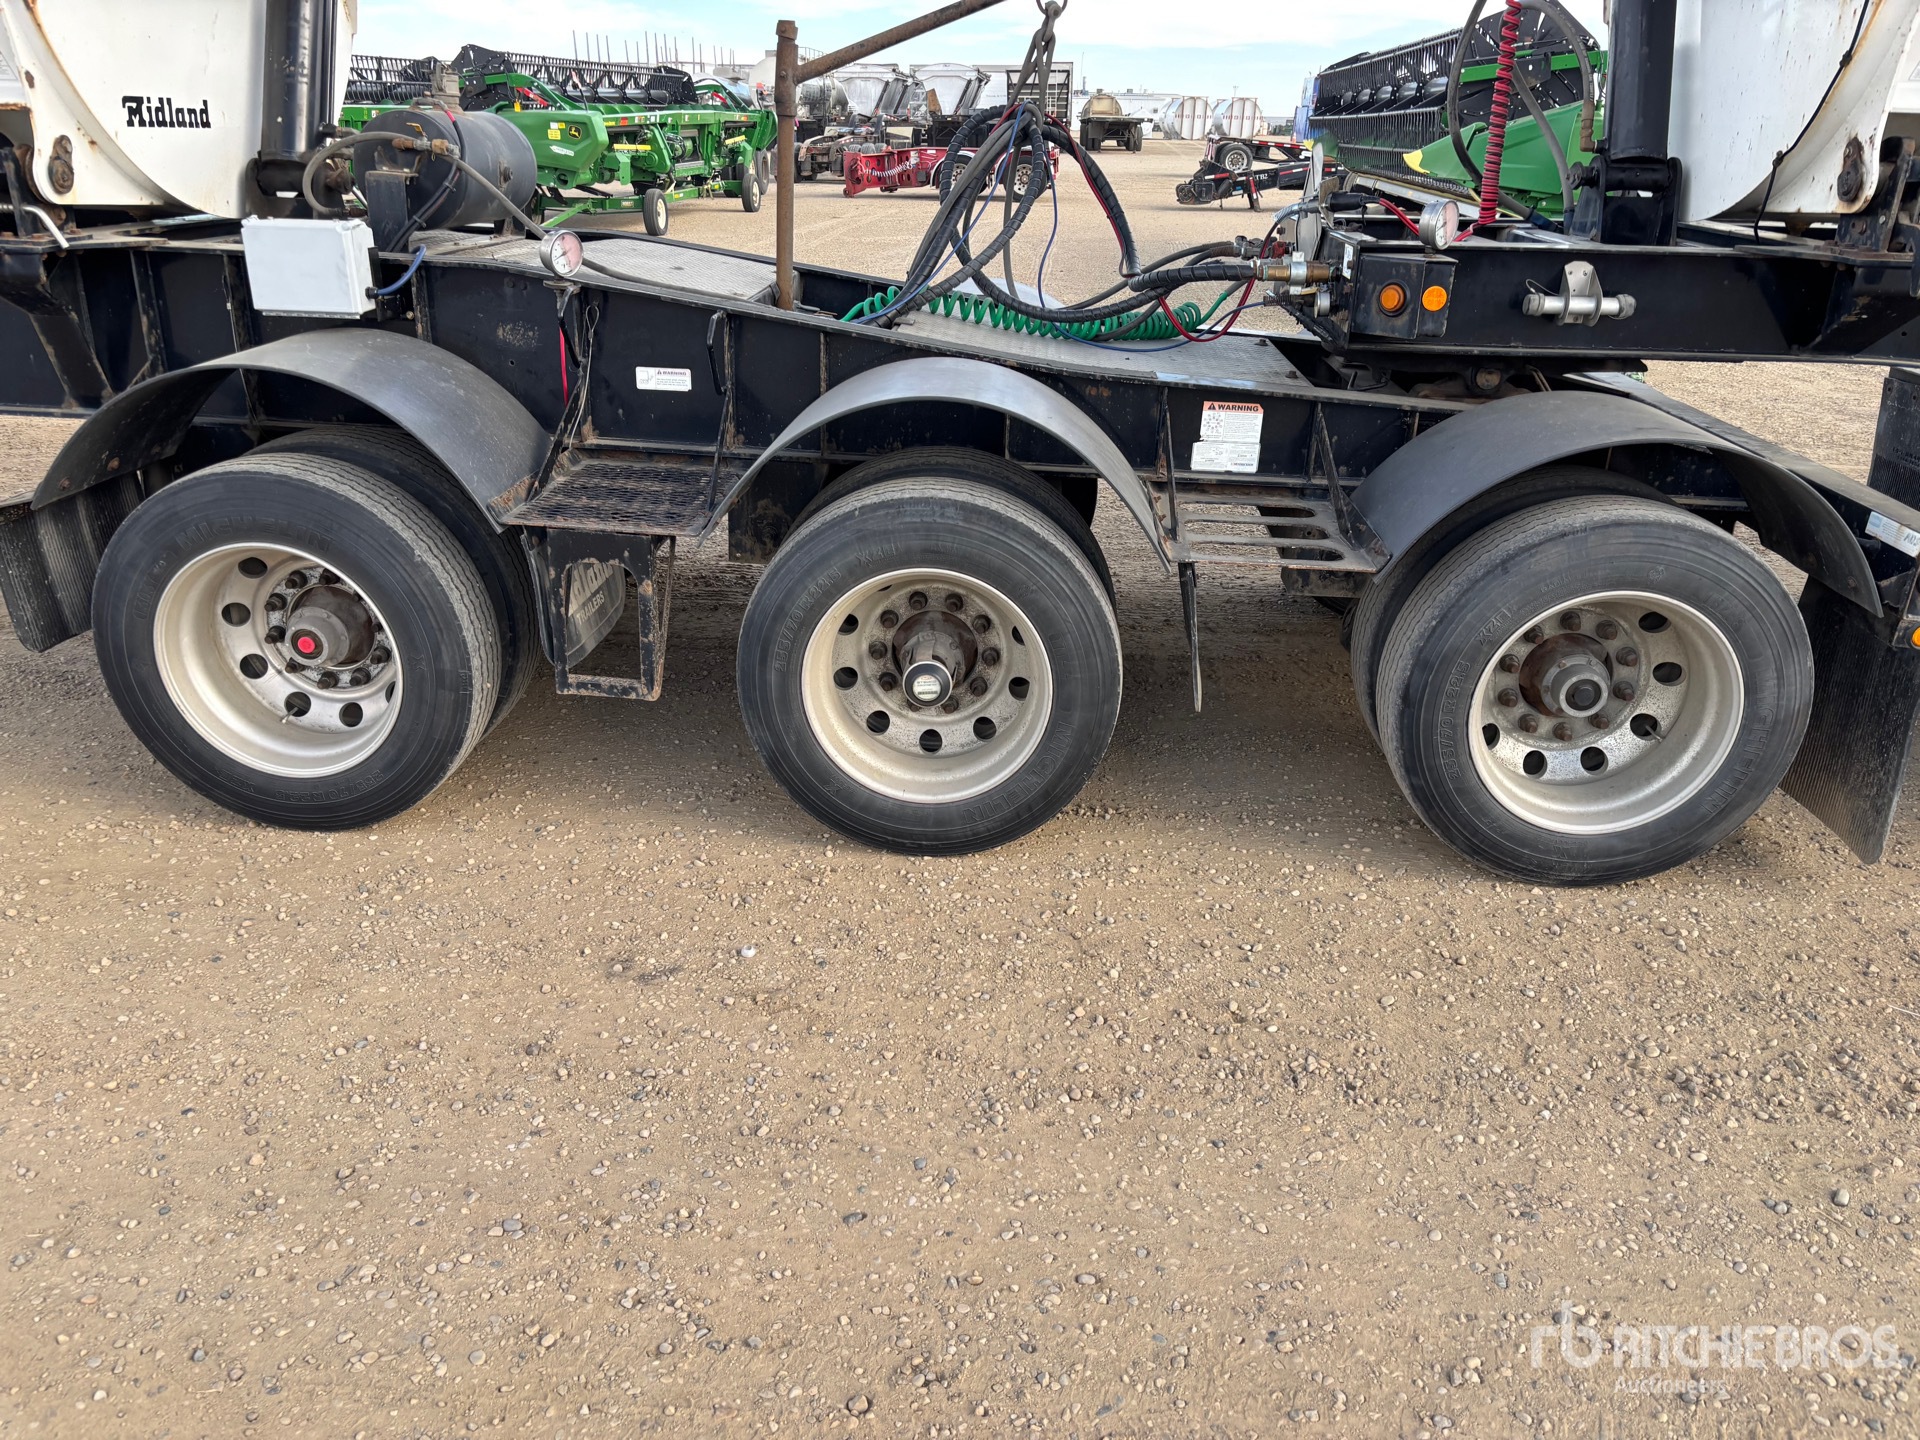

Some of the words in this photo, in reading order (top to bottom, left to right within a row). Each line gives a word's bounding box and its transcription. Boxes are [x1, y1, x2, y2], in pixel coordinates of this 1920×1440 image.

[121, 95, 211, 129] Midland
[1217, 404, 1259, 412] WARNING
[576, 591, 605, 625] TRAILERS
[961, 720, 1075, 825] MICHELIN
